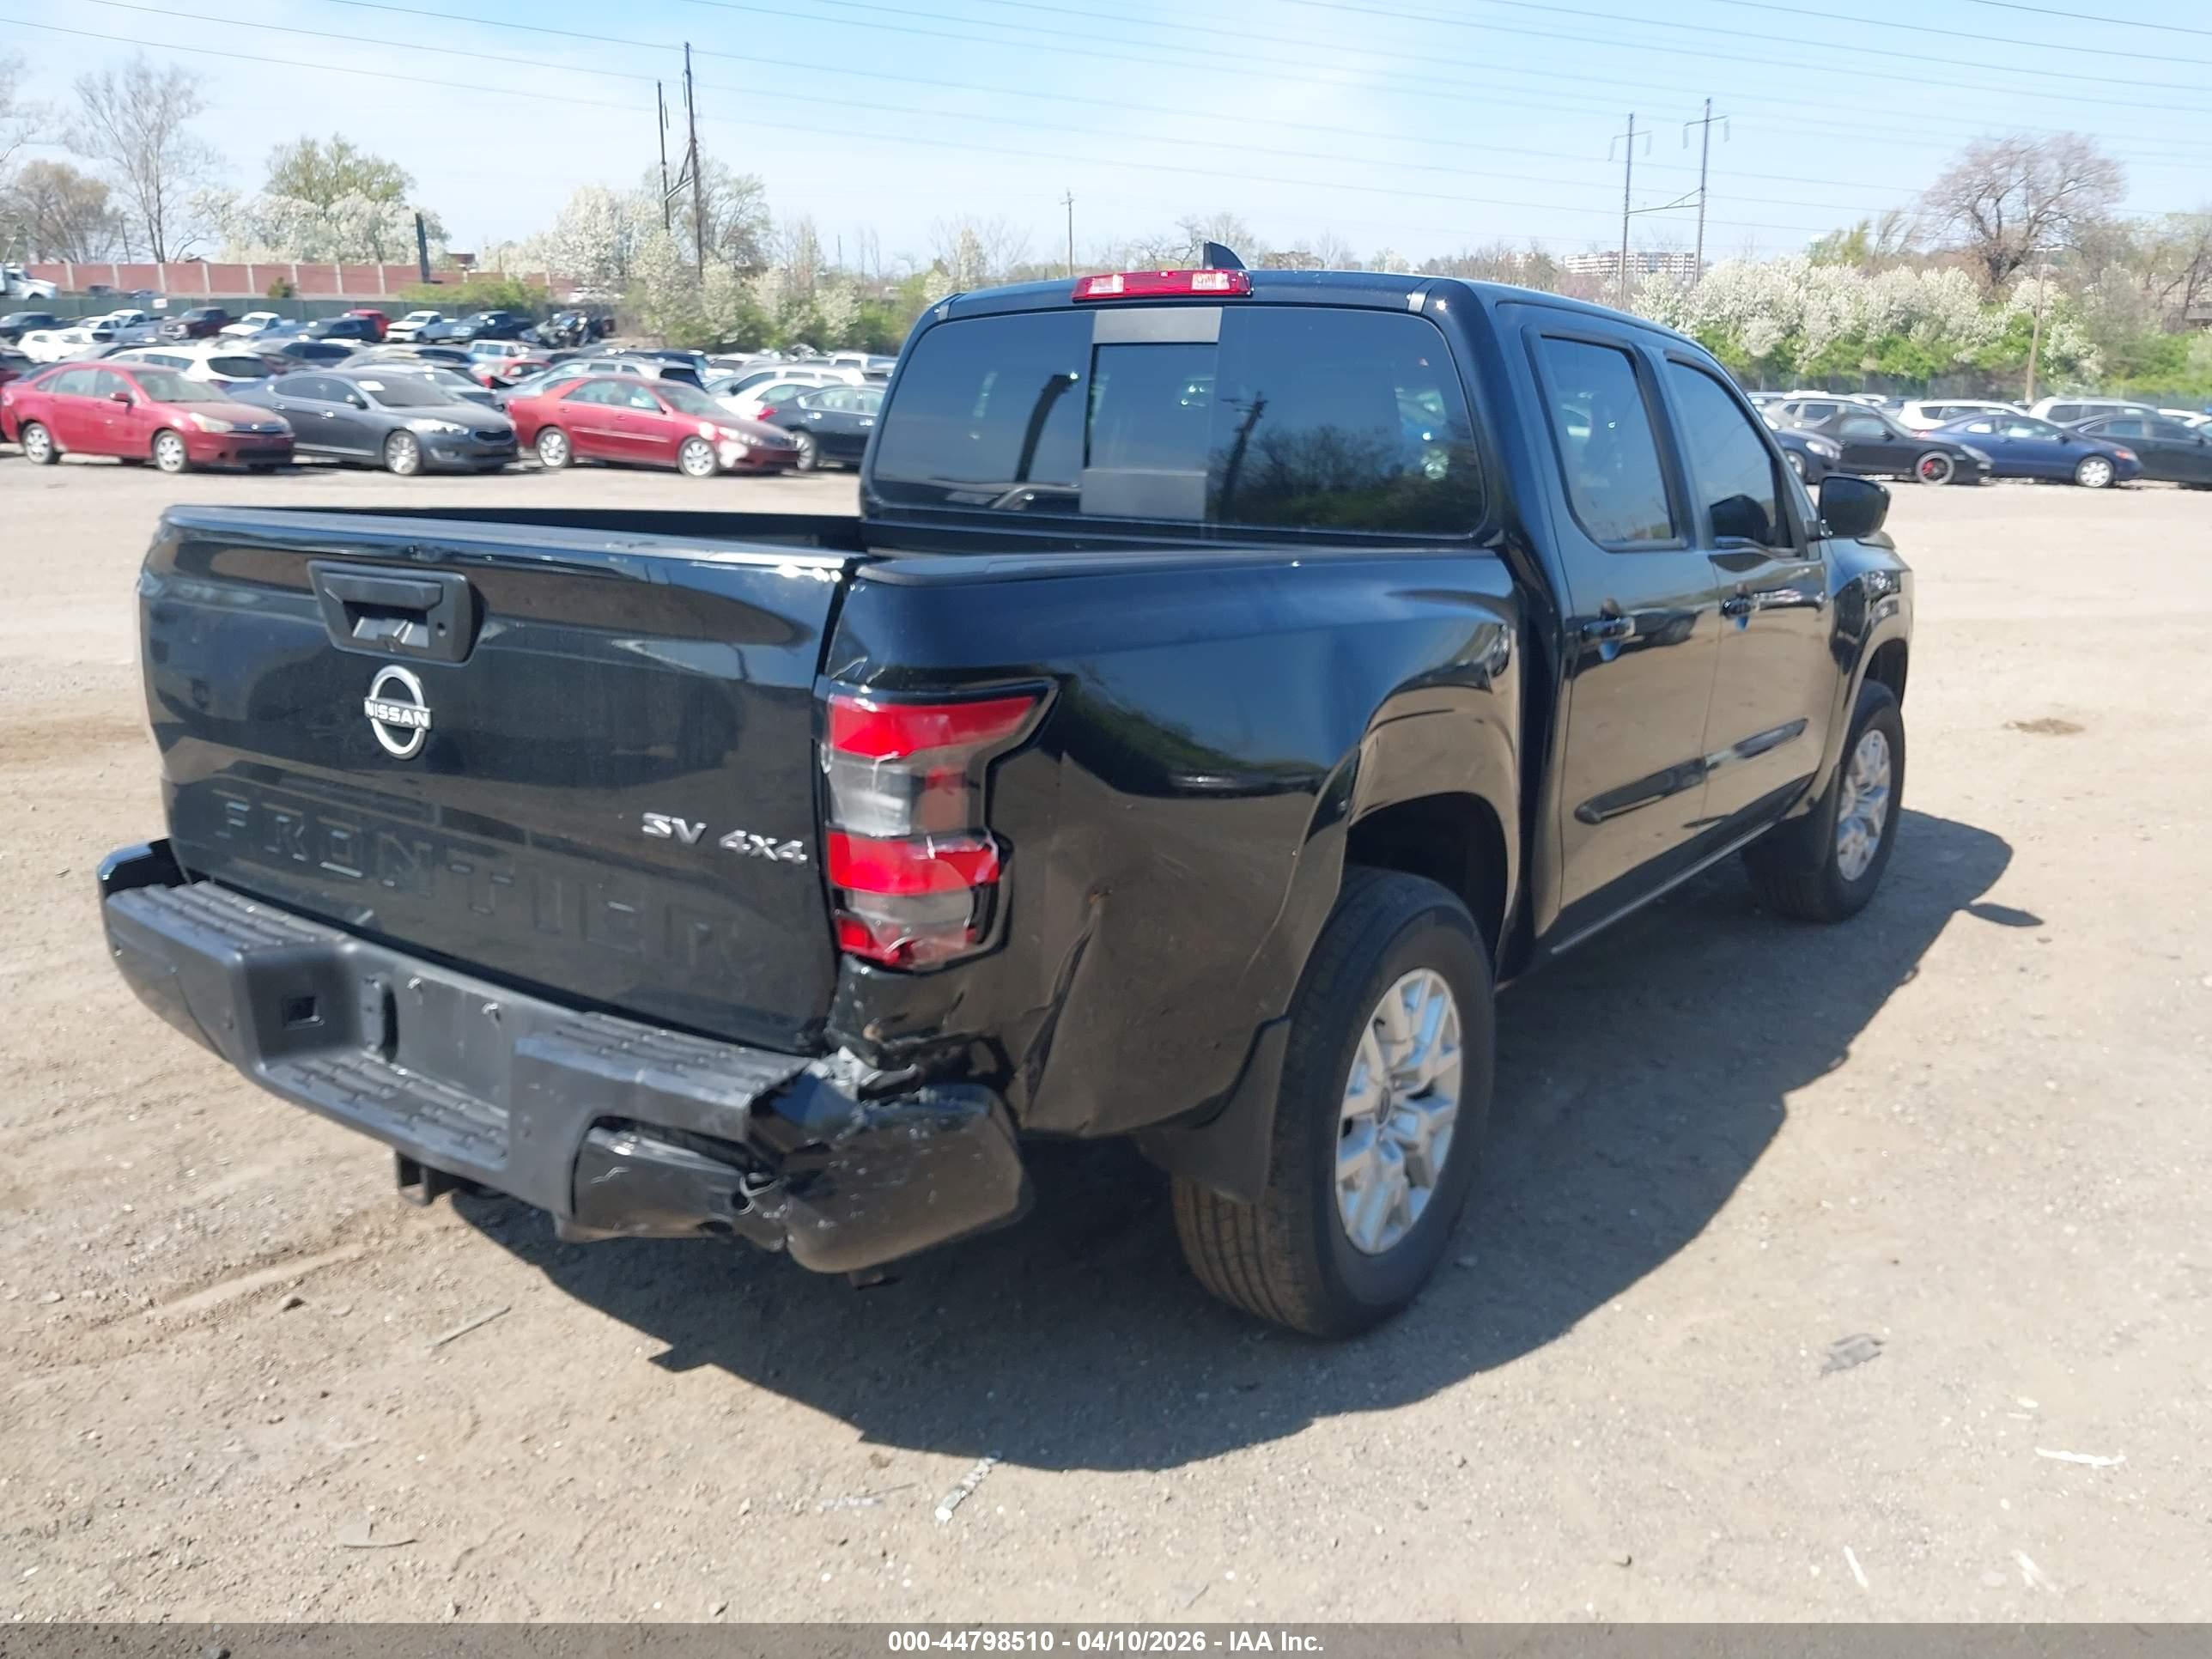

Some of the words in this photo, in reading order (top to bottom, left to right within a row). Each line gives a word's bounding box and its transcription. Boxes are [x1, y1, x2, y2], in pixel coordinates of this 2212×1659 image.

[364, 701, 429, 727] NISSAN
[642, 812, 707, 844] SV
[211, 788, 744, 977] FRONTIER
